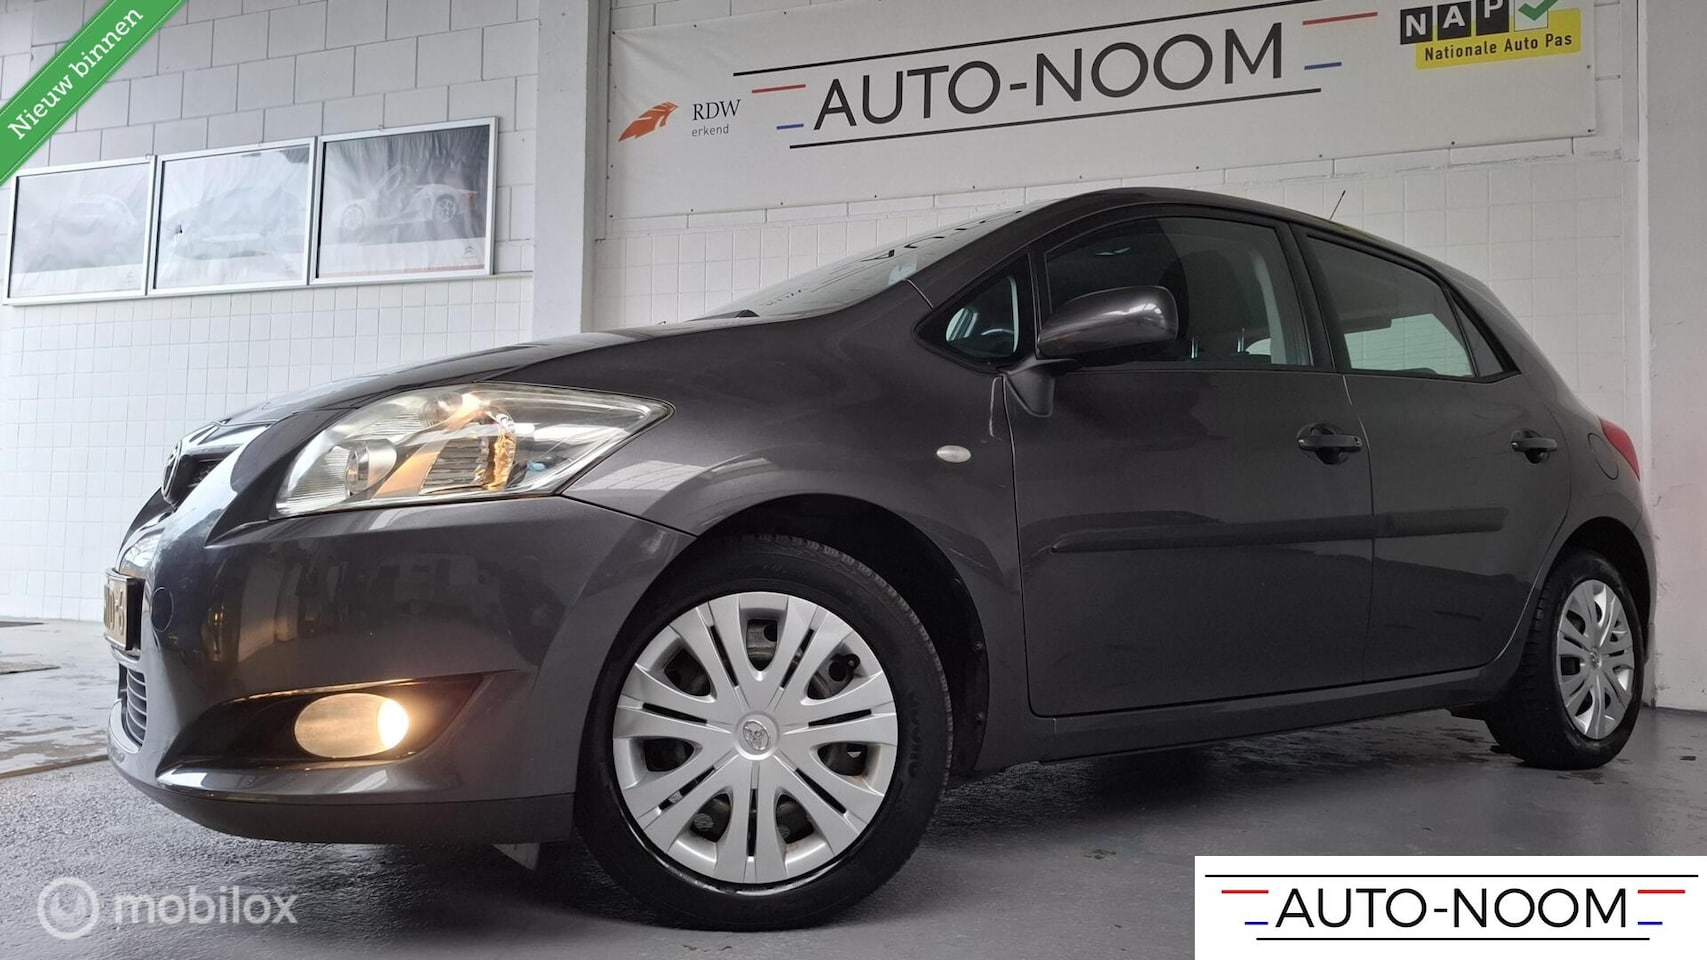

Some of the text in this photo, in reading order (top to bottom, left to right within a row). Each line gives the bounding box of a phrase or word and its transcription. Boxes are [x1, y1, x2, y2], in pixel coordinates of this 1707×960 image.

[1405, 0, 1504, 37] NAP
[1425, 33, 1572, 61] Nationale Auto Pas
[813, 22, 1283, 131] AUTO-NOOM
[692, 99, 742, 121] RDW
[691, 124, 729, 137] erkend
